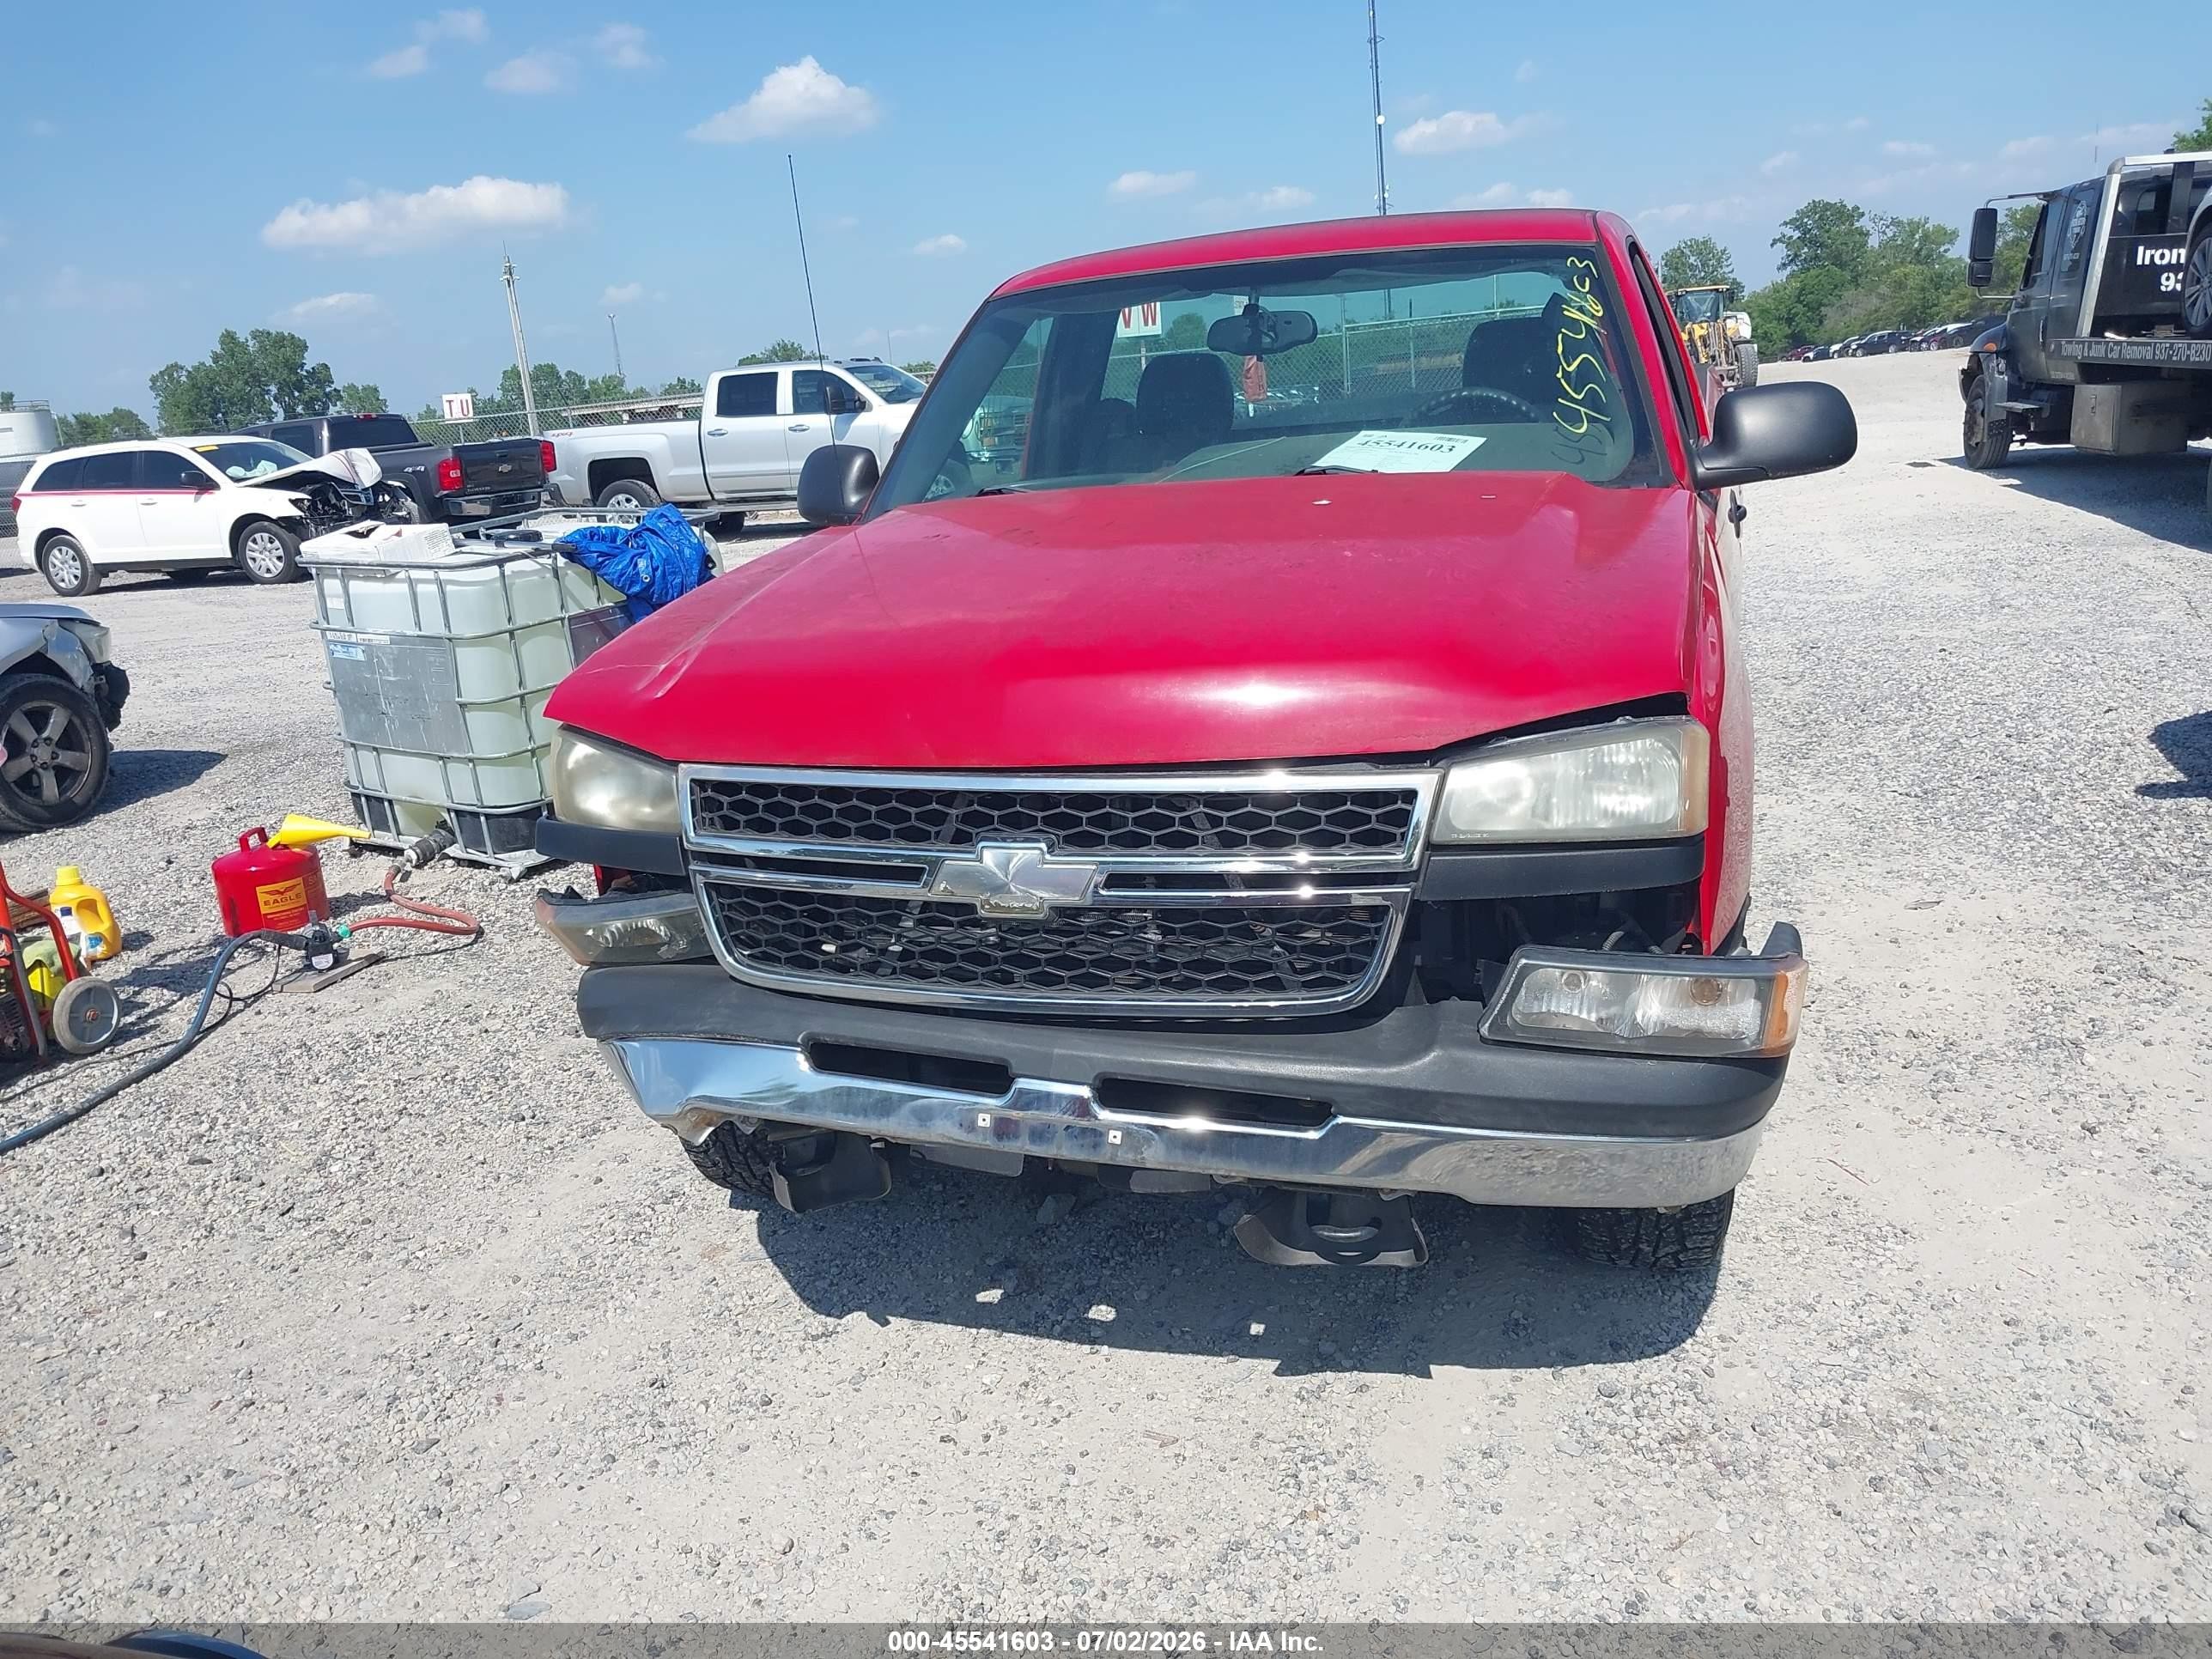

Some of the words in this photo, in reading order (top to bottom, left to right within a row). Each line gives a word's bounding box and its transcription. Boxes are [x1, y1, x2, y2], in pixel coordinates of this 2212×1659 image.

[2061, 341, 2082, 359] Towing
[2089, 343, 2106, 357] Junk
[2107, 342, 2120, 359] Car
[2122, 342, 2153, 360] Removal
[2154, 343, 2212, 362] 937-270-8230
[1356, 438, 1457, 453] 45541603
[263, 893, 303, 907] EAGLE
